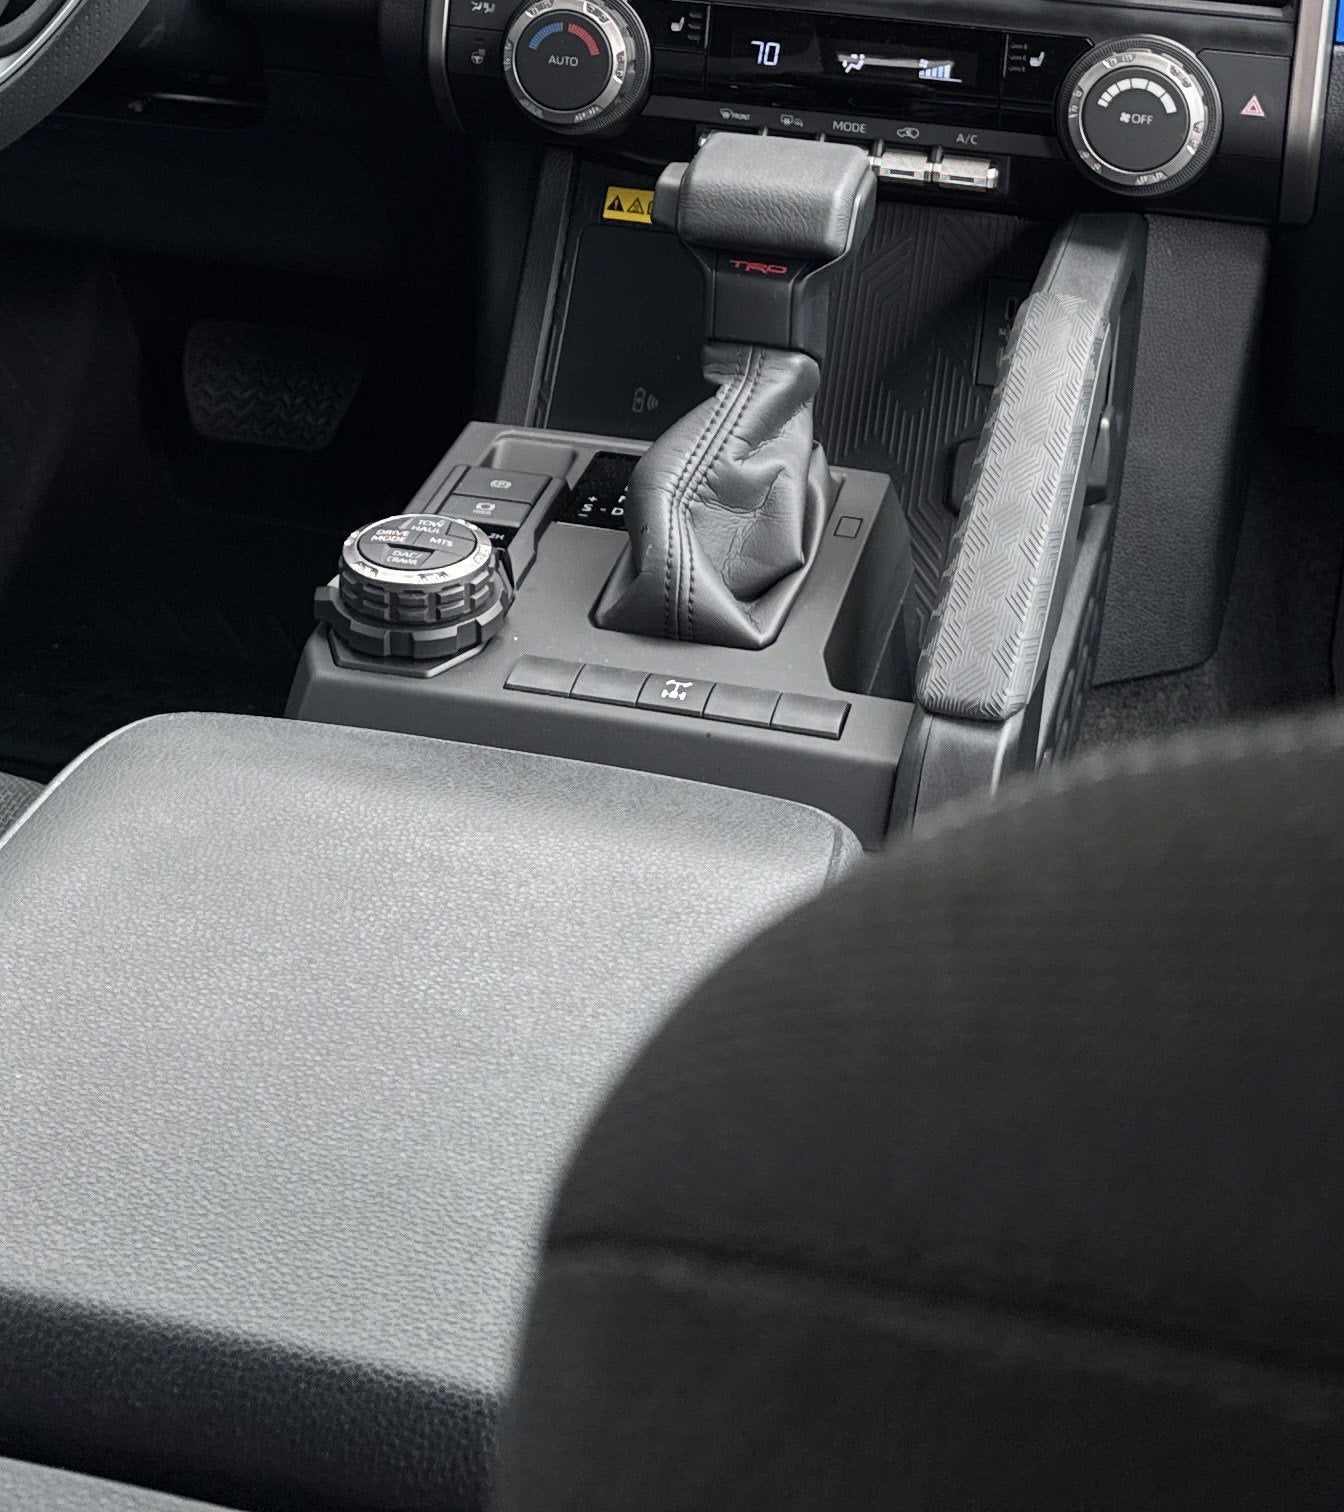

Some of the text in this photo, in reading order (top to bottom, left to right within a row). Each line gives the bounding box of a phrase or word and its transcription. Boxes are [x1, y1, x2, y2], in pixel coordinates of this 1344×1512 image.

[751, 40, 781, 67] 70
[548, 55, 579, 67] AUTO
[1131, 114, 1154, 125] OFF
[832, 121, 867, 134] MODE
[956, 133, 979, 146] A/C
[729, 259, 788, 276] TRD
[375, 528, 410, 537] DRIVE
